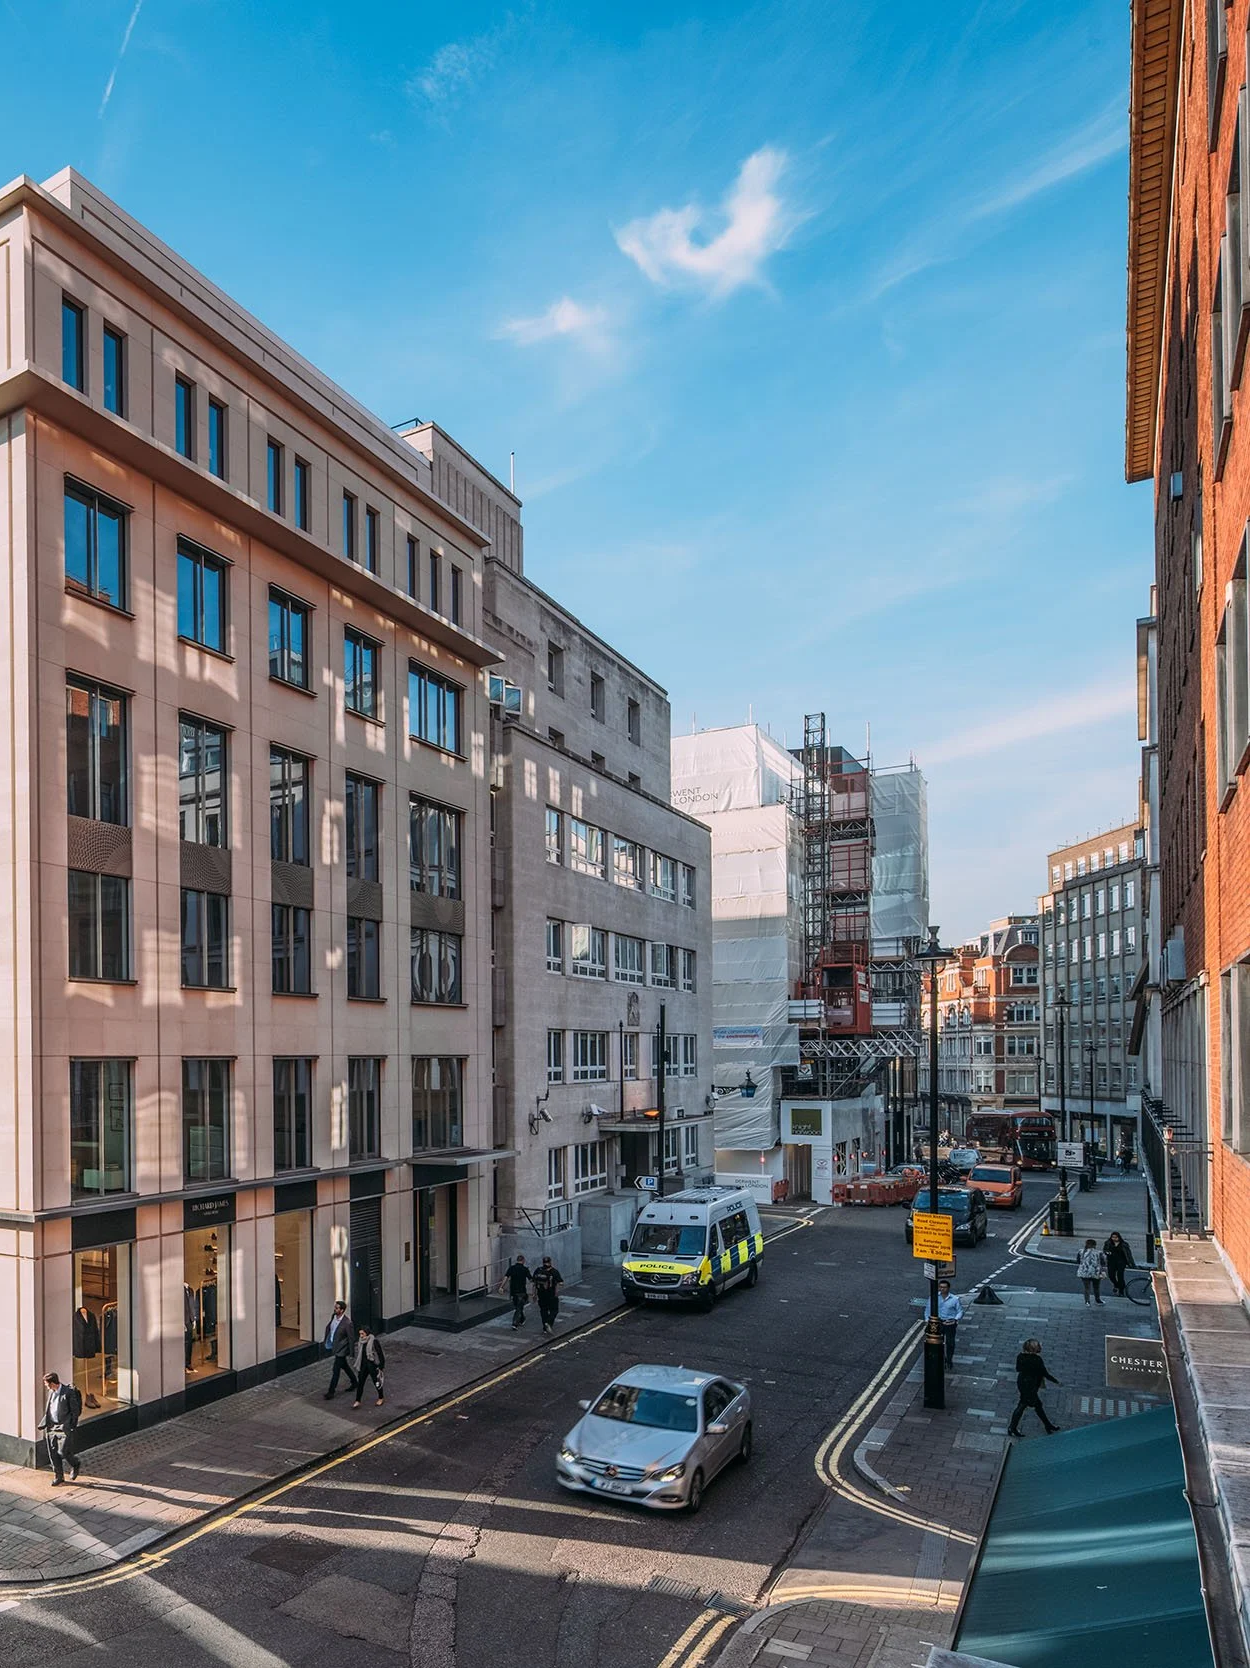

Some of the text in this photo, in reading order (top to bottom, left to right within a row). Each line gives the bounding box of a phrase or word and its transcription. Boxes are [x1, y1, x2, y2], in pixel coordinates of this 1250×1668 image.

[675, 792, 718, 805] LONDON
[727, 1200, 743, 1212] POLICE
[1110, 1355, 1163, 1369] CHESTER
